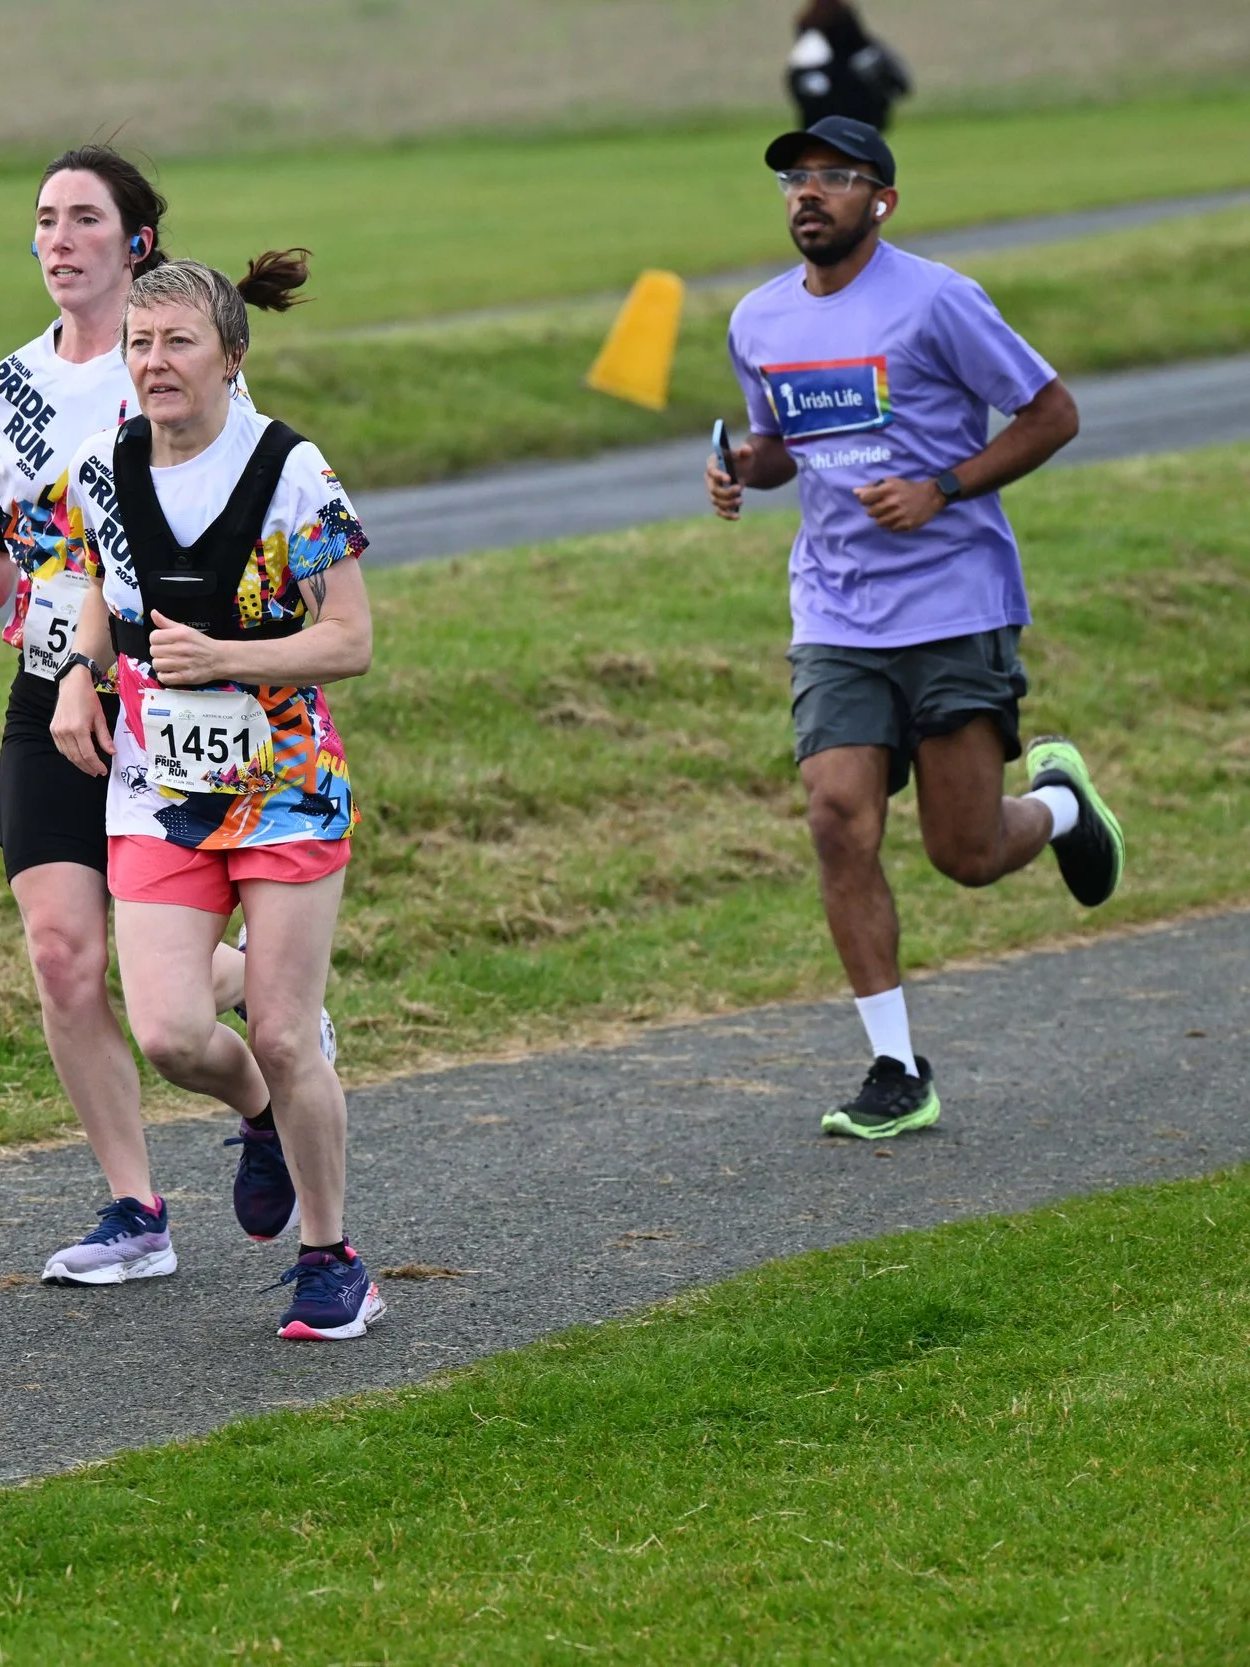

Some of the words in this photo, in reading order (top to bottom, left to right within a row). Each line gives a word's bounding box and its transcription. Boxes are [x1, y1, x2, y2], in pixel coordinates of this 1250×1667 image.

[799, 390, 833, 411] Irish
[834, 387, 863, 408] Life
[3, 411, 54, 472] RUN
[16, 458, 36, 481] 2024
[87, 454, 115, 485] DUBL
[79, 460, 123, 527] PRI
[114, 566, 139, 591] 2024
[29, 647, 54, 661] PRIDE
[42, 658, 59, 670] RUN
[160, 723, 250, 764] 1451
[154, 757, 182, 769] PRIDE
[168, 767, 188, 778] RUN
